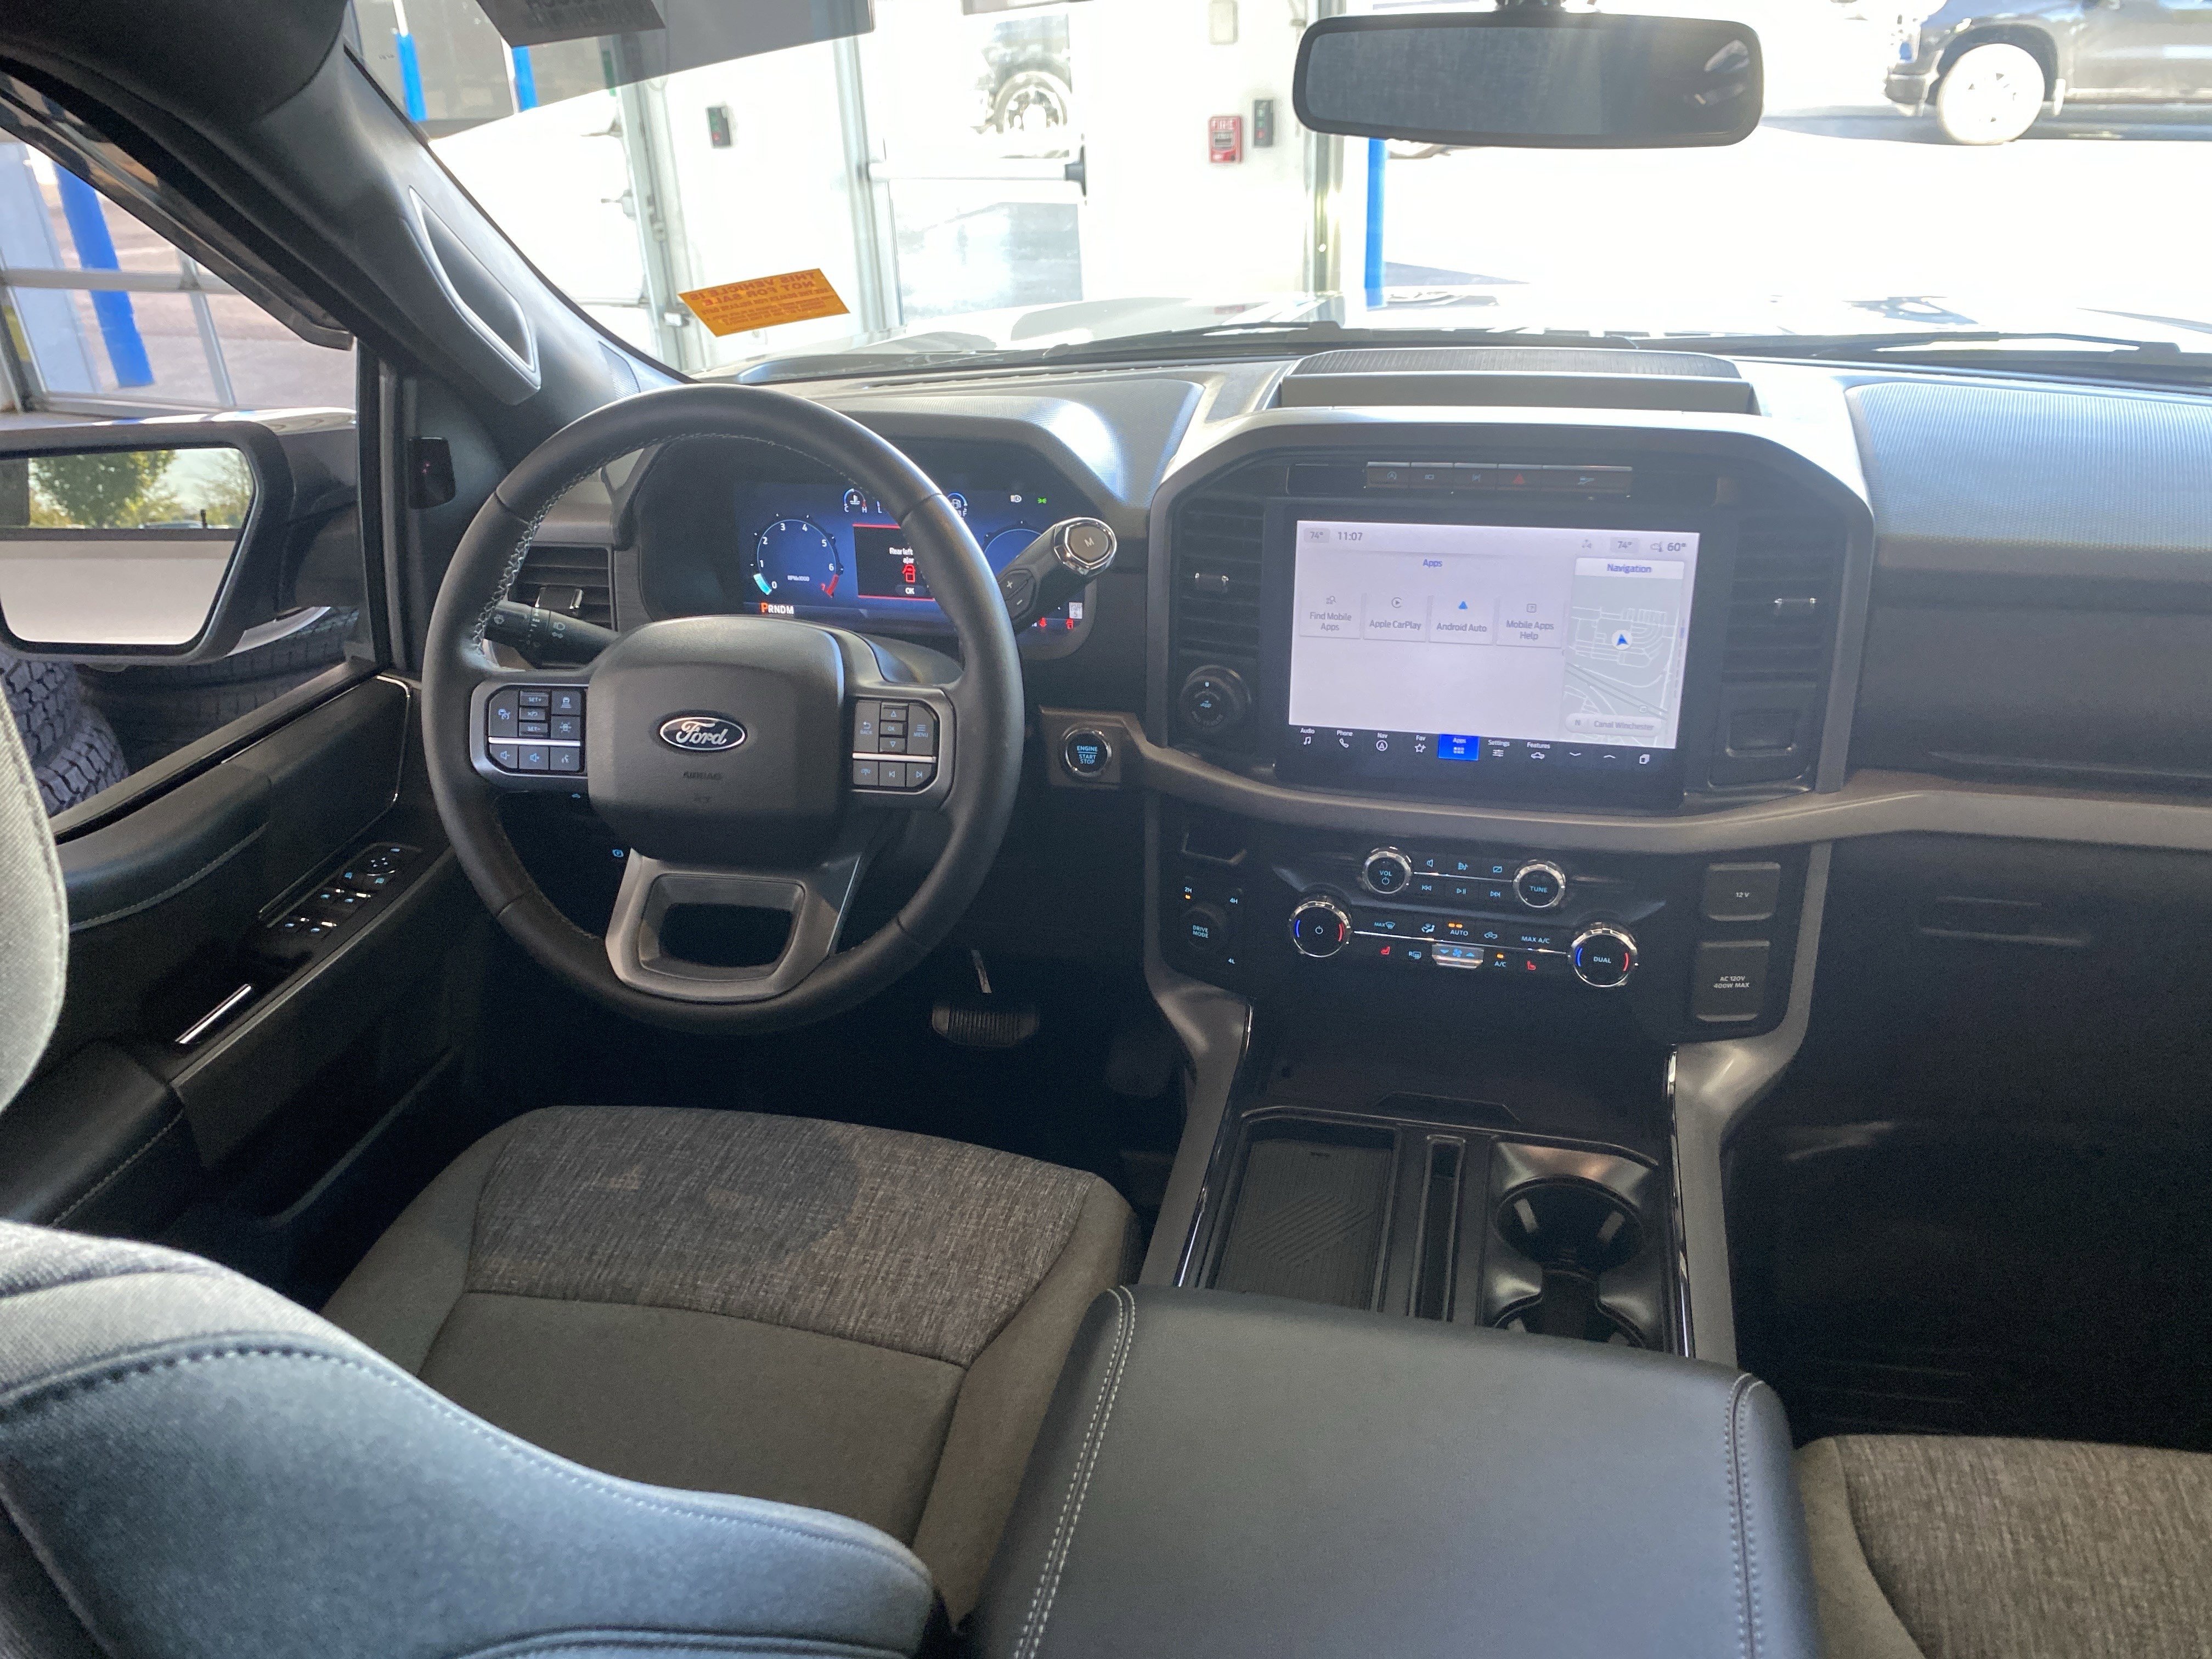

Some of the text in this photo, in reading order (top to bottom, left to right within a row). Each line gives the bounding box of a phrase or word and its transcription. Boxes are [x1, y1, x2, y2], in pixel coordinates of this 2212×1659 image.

[763, 537, 768, 545] 2
[1338, 532, 1363, 541] 11:07
[1084, 537, 1094, 548] M
[828, 563, 834, 571] 6
[1423, 558, 1443, 568] Apps
[1607, 563, 1653, 574] Navigation
[771, 581, 777, 589] 0
[1310, 612, 1352, 621] Find Mobile
[1321, 623, 1339, 632] Apps
[1369, 620, 1421, 631] Apple CarPlay
[1436, 623, 1487, 633] Android Auto
[1506, 620, 1554, 631] Mobile Apps
[1520, 631, 1538, 641] Help
[1594, 720, 1655, 731] Canal Winchester
[676, 721, 729, 744] Ford
[1529, 885, 1548, 893] TUNE
[1192, 924, 1209, 933] DRIVE
